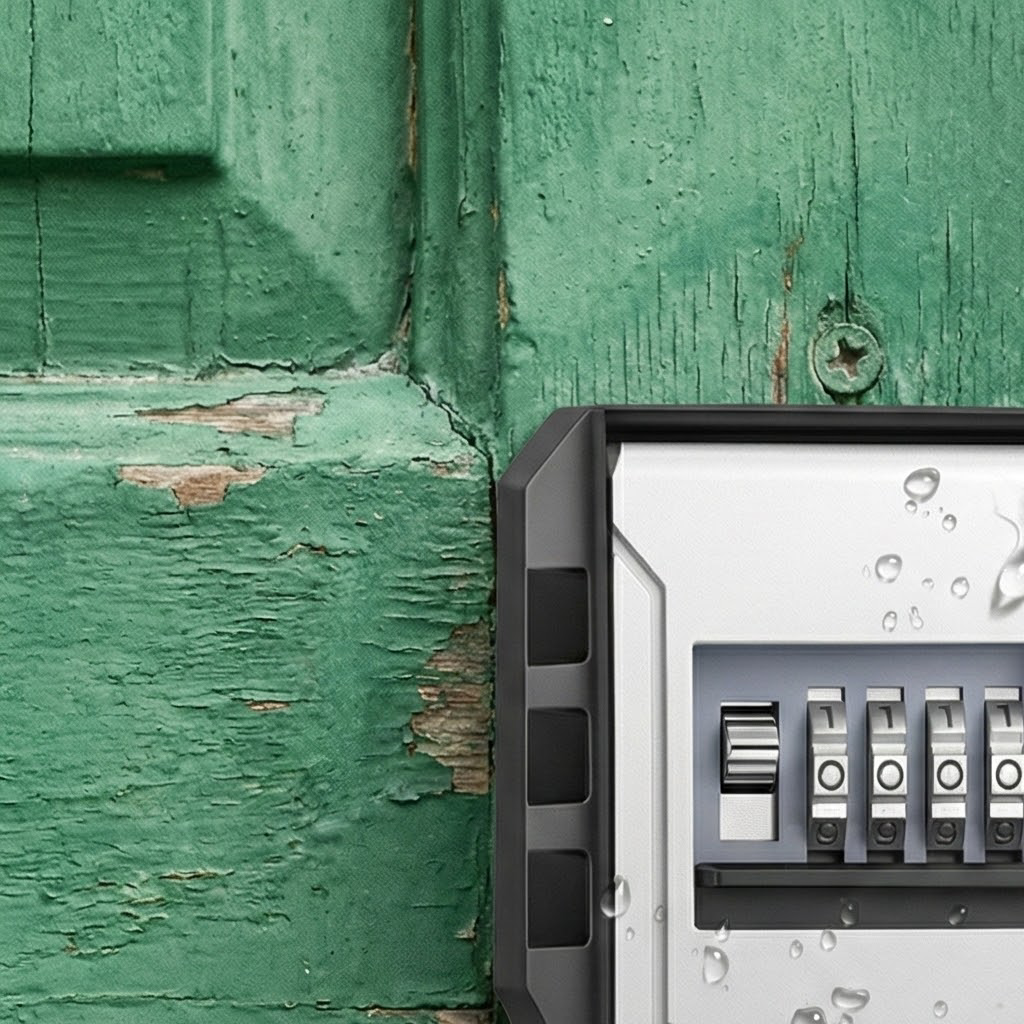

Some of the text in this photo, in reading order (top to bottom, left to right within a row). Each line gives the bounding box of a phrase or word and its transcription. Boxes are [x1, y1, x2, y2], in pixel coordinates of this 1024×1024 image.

[819, 704, 1012, 729] 1 1 1 1
